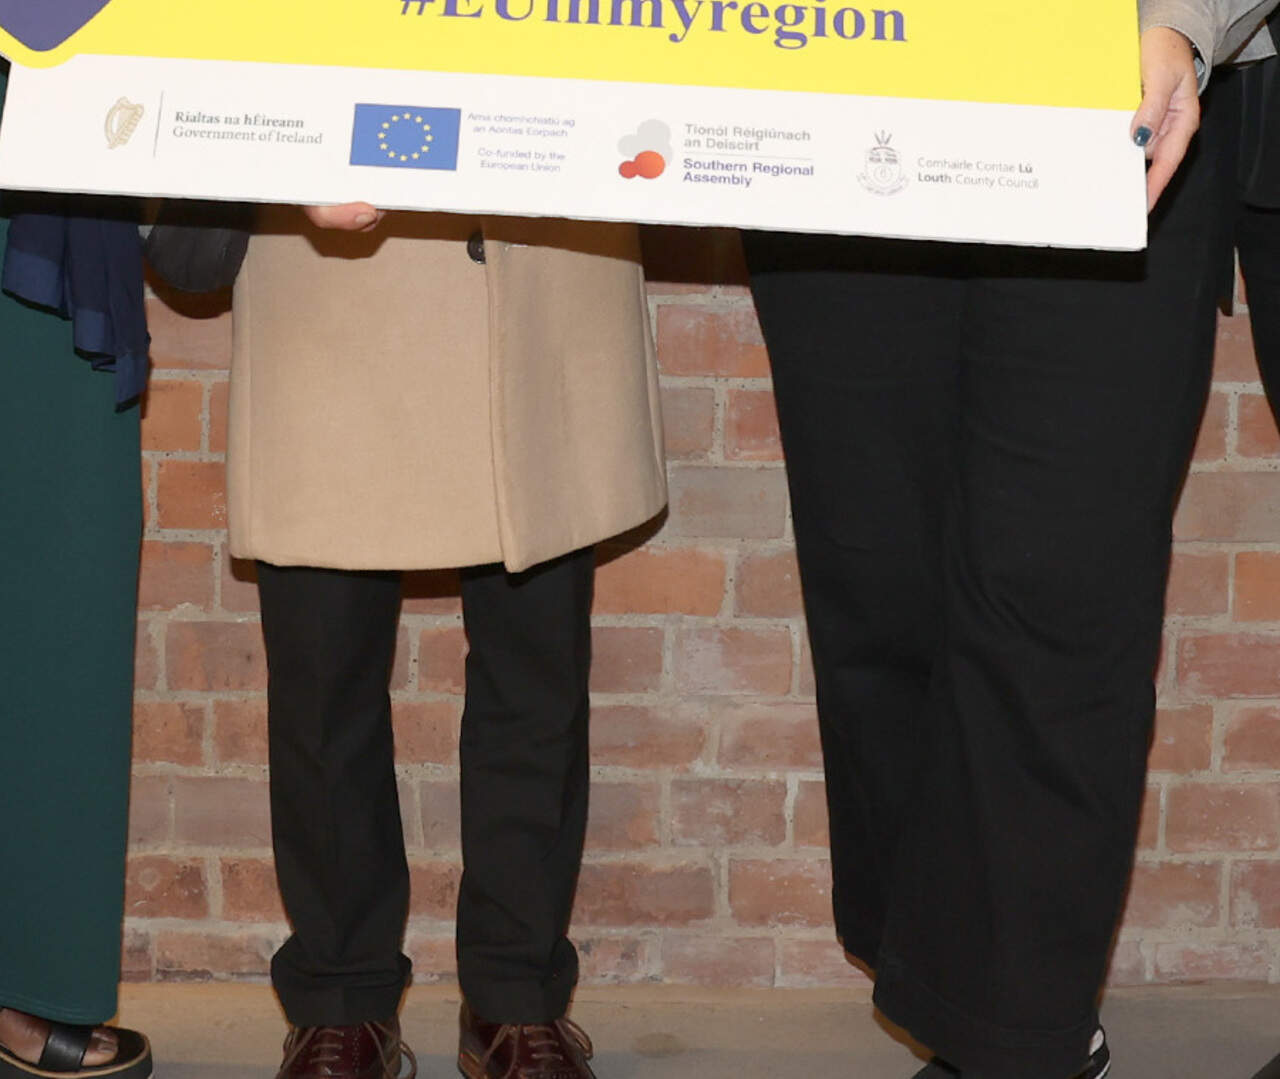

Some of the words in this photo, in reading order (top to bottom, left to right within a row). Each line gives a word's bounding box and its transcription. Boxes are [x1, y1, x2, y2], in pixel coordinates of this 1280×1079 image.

[175, 111, 220, 124] Rialtas
[224, 116, 240, 125] na
[244, 113, 305, 129] hÉireann
[173, 125, 256, 141] Government
[258, 129, 275, 142] of
[276, 131, 324, 145] Ireland
[685, 123, 728, 137] Tionól
[684, 138, 701, 148] an
[706, 138, 760, 151] Deiscirt
[477, 147, 532, 159] Co-funded
[534, 151, 546, 162] by
[549, 152, 566, 161] the
[480, 159, 529, 171] European
[531, 163, 561, 173] Union
[683, 158, 747, 172] Southern
[753, 162, 814, 177] Regional
[917, 157, 973, 171] Comhairle
[976, 160, 1015, 173] Contae
[683, 172, 753, 188] Assembly
[918, 172, 952, 184] Louth
[955, 173, 995, 188] County
[998, 176, 1040, 190] Council
